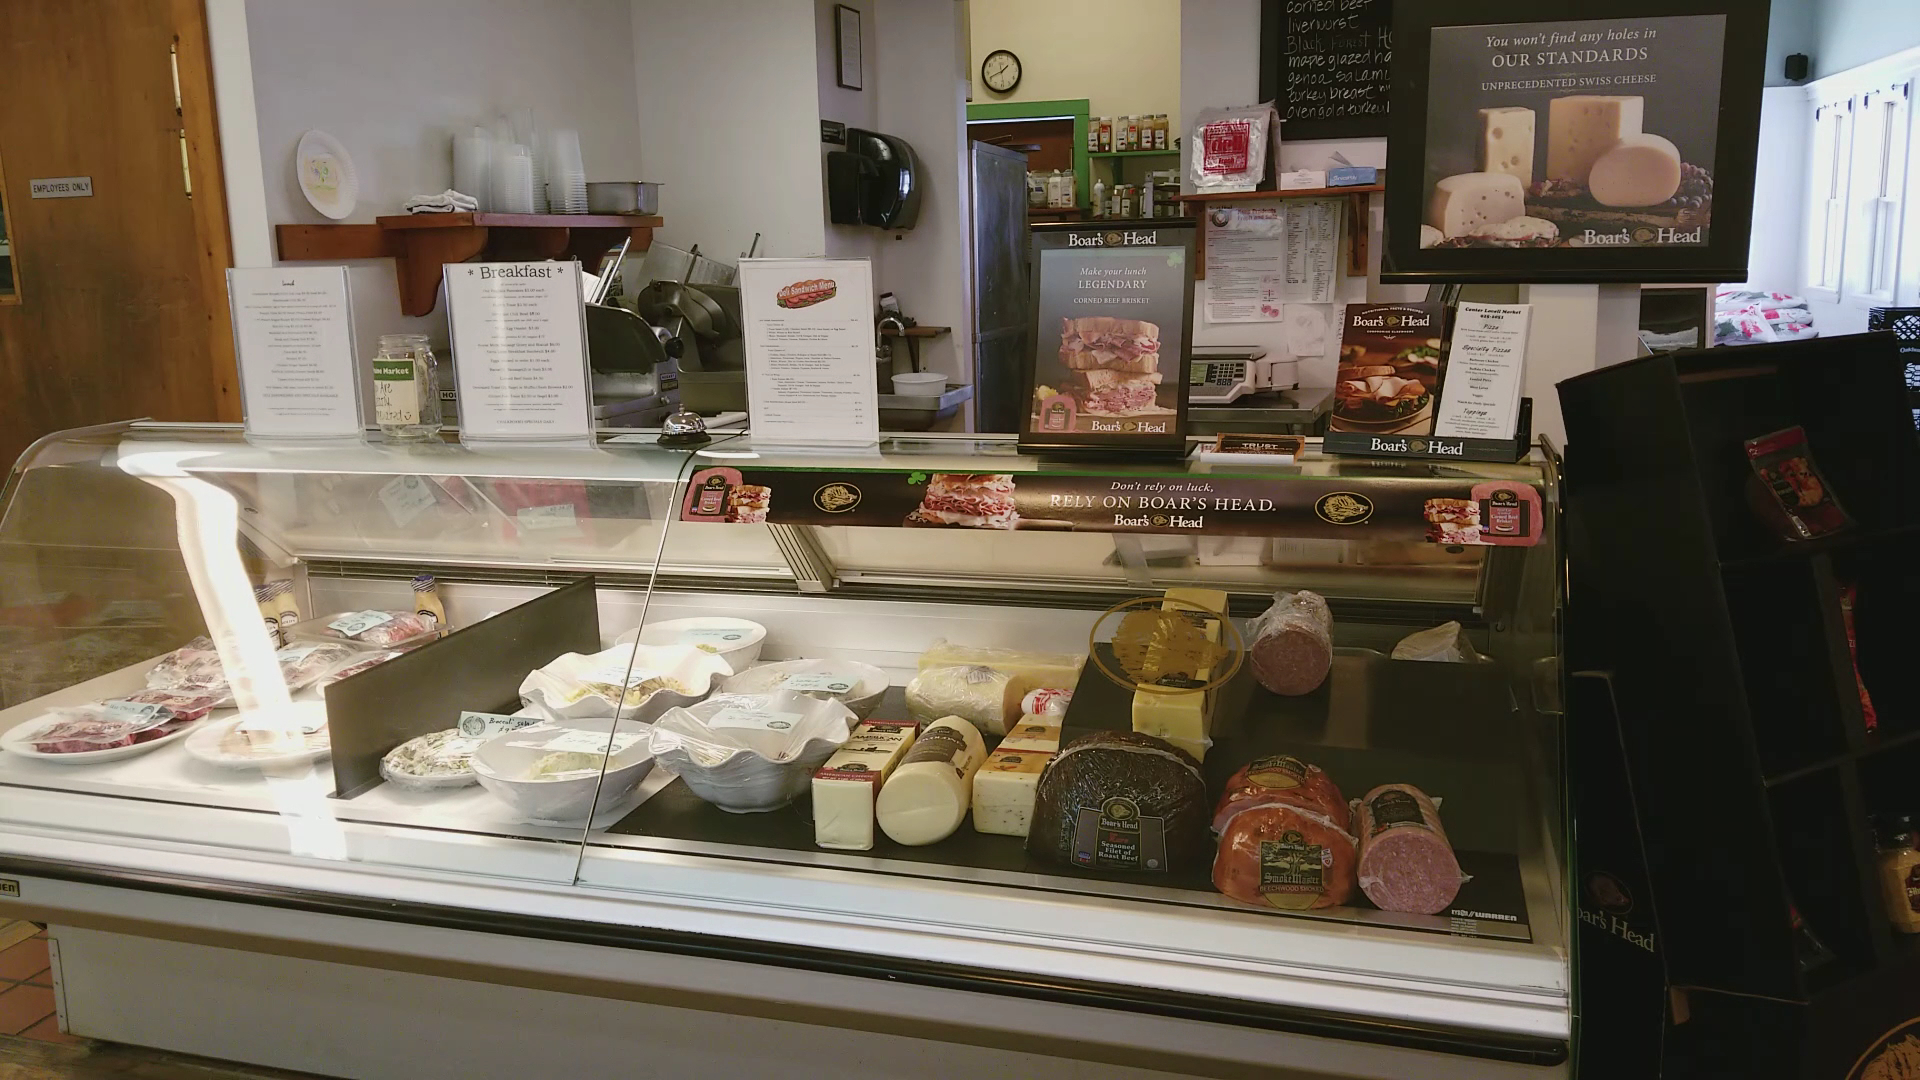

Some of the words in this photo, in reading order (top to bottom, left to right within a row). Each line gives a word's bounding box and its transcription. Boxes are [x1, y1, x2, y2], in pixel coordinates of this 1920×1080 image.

[1286, 0, 1335, 13] corned
[1289, 14, 1359, 33] liverwurst
[1486, 36, 1508, 48] You
[1513, 33, 1546, 46] won't
[1548, 31, 1576, 47] find
[1579, 31, 1603, 44] any
[1607, 28, 1639, 41] holes
[1644, 28, 1657, 39] in
[1328, 49, 1371, 71] glazed
[1492, 53, 1530, 68] OUR
[1536, 47, 1648, 65] STANDARDS
[1286, 72, 1333, 91] genoa
[1481, 79, 1576, 91] UNPRECEDENTED
[1579, 76, 1611, 86] SWISS
[1613, 74, 1657, 84] CHEESE
[1288, 88, 1327, 106] turkey
[1330, 84, 1376, 100] breast
[33, 183, 70, 193] EMPLOYEES
[72, 182, 89, 191] ONLY
[1068, 233, 1103, 247] Boar's
[1123, 231, 1156, 245] Head
[1584, 228, 1630, 245] Boar's
[1656, 226, 1701, 244] Head
[479, 264, 552, 279] Breakfast
[1080, 267, 1102, 276] Make
[1103, 269, 1122, 279] your
[1124, 267, 1147, 276] lunch
[790, 284, 818, 295] Sandwich
[819, 281, 835, 290] Menu
[1078, 280, 1147, 289] LEGENDARY
[1353, 315, 1384, 327] Boar's
[1401, 314, 1430, 327] Head
[1462, 345, 1490, 353] Specialty
[383, 367, 409, 375] Market
[1463, 408, 1488, 417] Toppings
[1091, 420, 1121, 432] Boar's
[1137, 422, 1166, 433] Head
[1371, 438, 1407, 452] Boar's
[1428, 440, 1464, 455] Head
[1111, 481, 1141, 492] Don't
[1144, 482, 1166, 494] rely
[1169, 484, 1183, 492] on
[1186, 482, 1214, 493] luck,
[1050, 494, 1097, 508] RELY
[1102, 495, 1132, 510] ON
[1139, 496, 1207, 511] BOAR'S
[1114, 514, 1150, 527] Boar's
[1169, 515, 1204, 529] Head
[1101, 817, 1121, 828] Boar's
[1121, 820, 1138, 829] Head
[1101, 841, 1136, 851] Seasoned
[1098, 851, 1120, 860] Roast
[1121, 854, 1139, 862] Beef
[1264, 872, 1320, 884] SmokeMaster
[1611, 915, 1655, 953] Head
